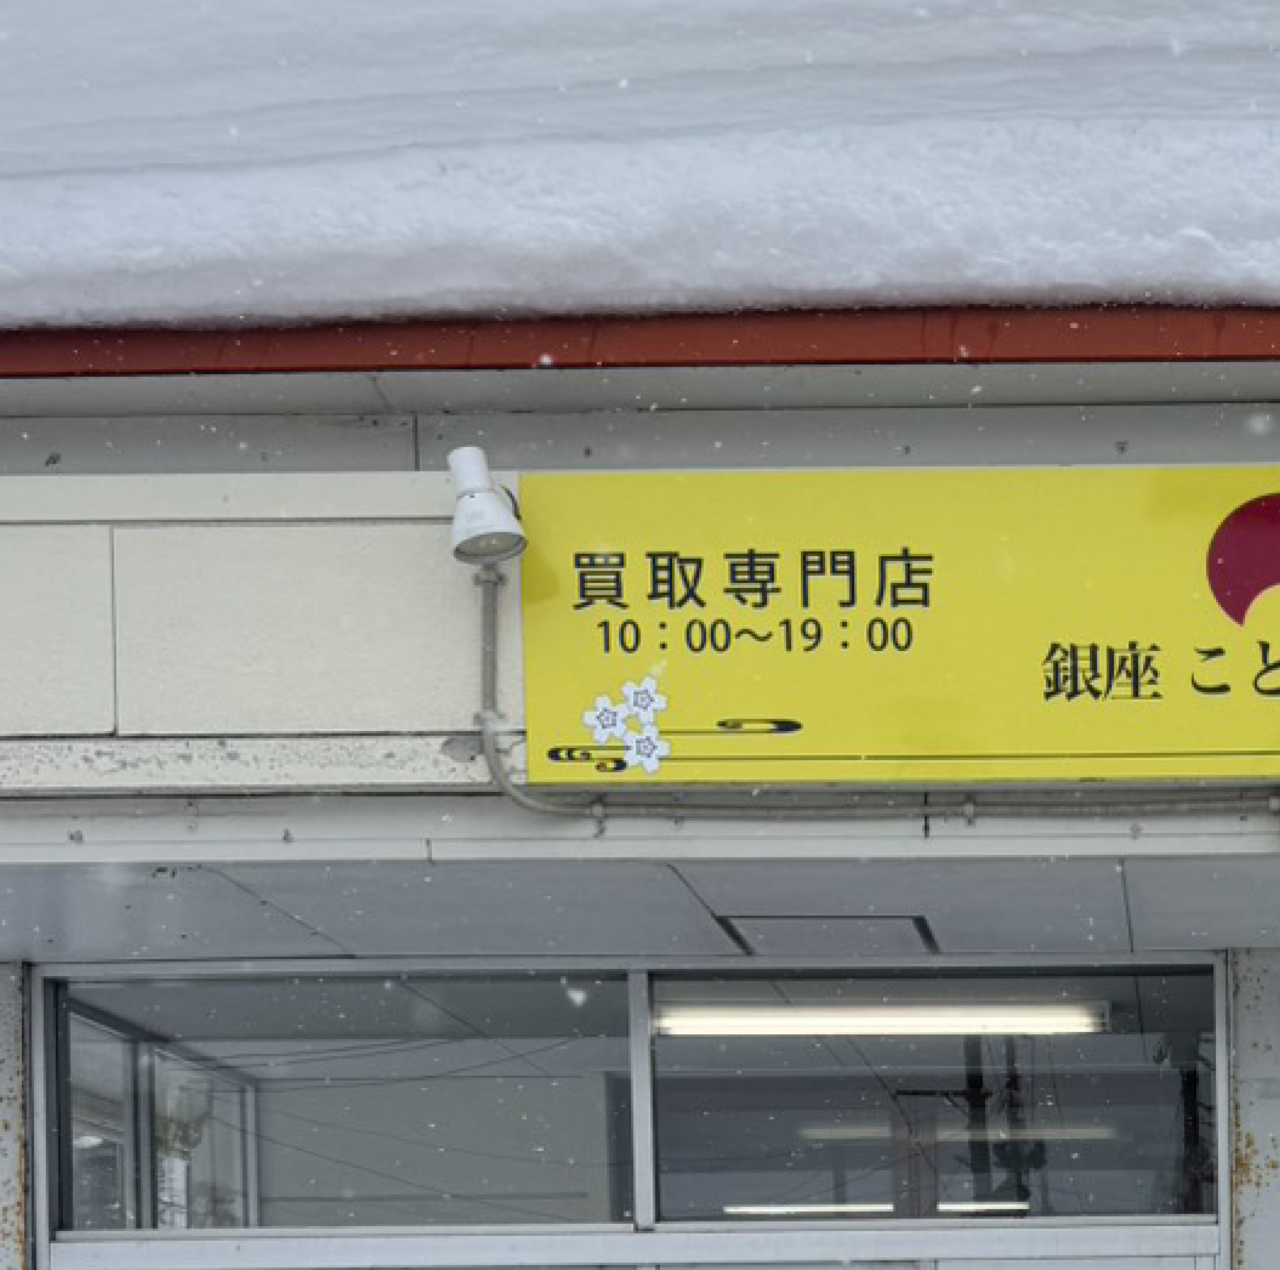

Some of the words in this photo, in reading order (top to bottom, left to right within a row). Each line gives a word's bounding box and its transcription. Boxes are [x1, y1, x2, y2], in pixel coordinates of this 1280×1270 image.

[572, 546, 936, 612] 買取専門店
[1040, 638, 1164, 704] 銀座
